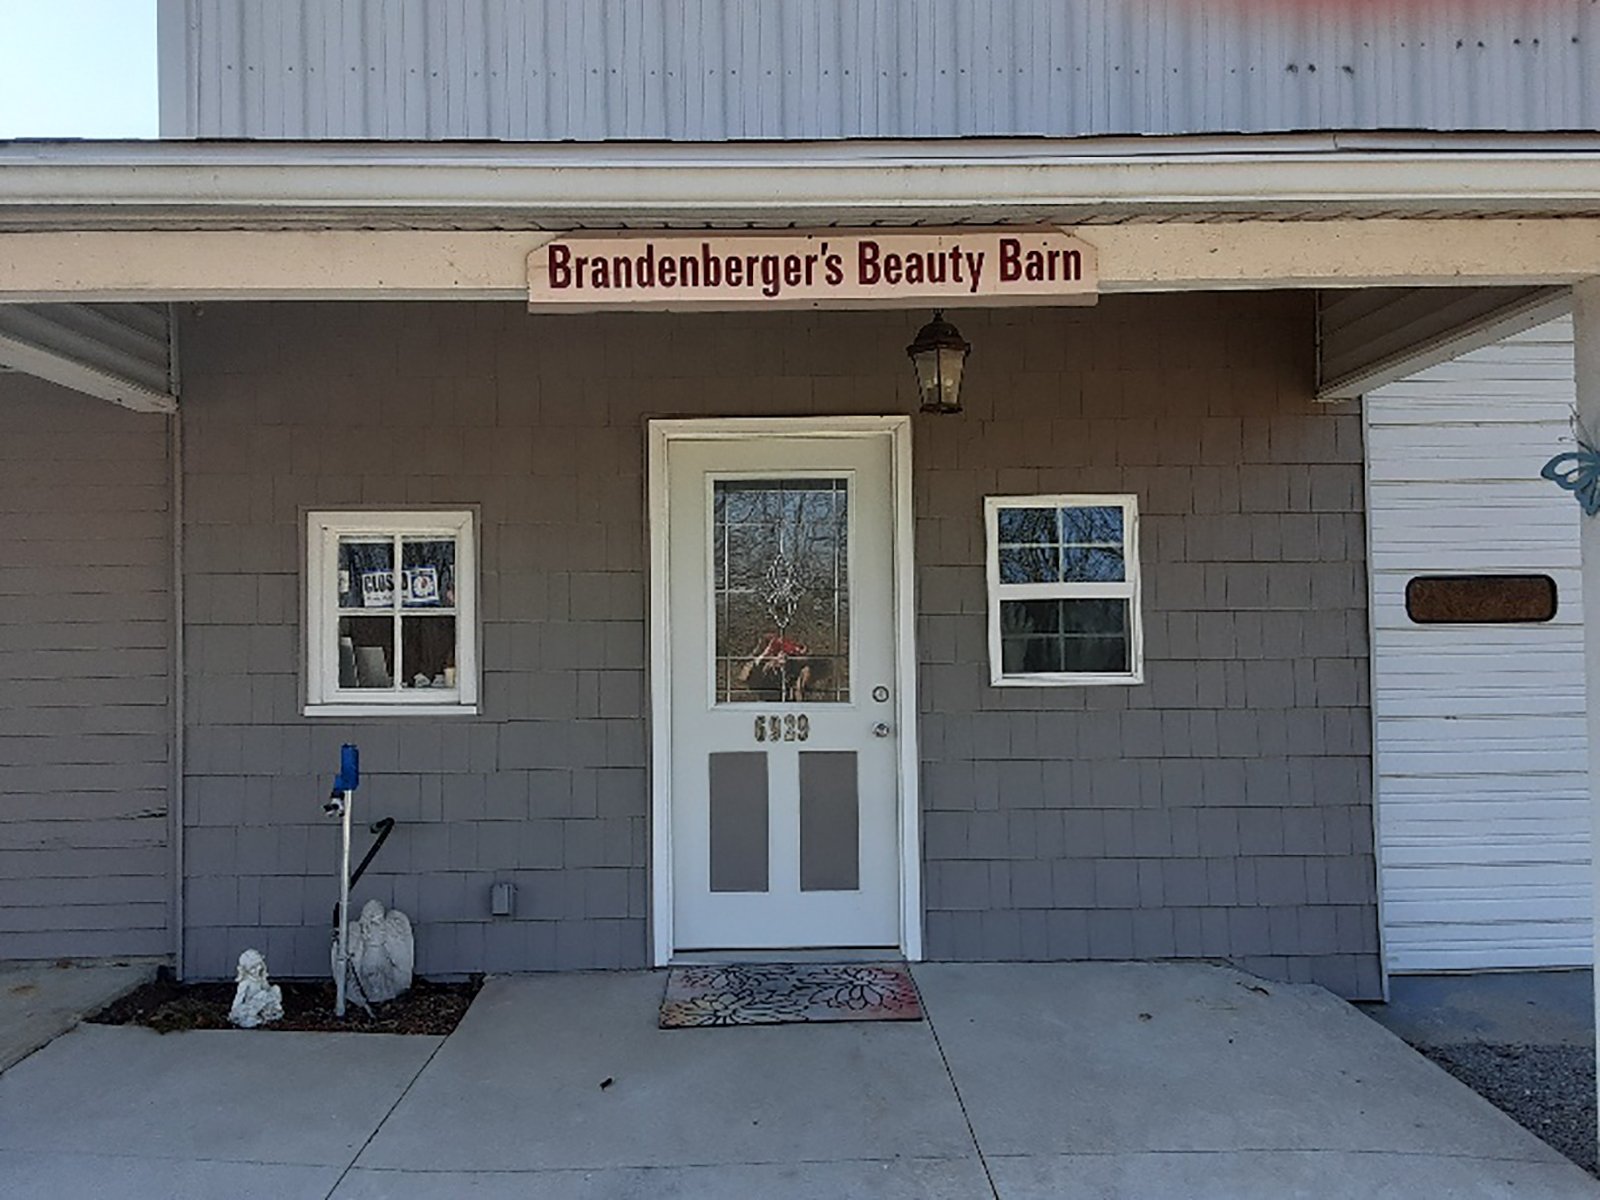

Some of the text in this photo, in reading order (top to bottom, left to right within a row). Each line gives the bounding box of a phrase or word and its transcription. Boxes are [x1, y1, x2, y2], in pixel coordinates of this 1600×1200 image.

[548, 238, 1082, 298] Brandenberger's Beauty Barn
[364, 572, 409, 594] CLOSD
